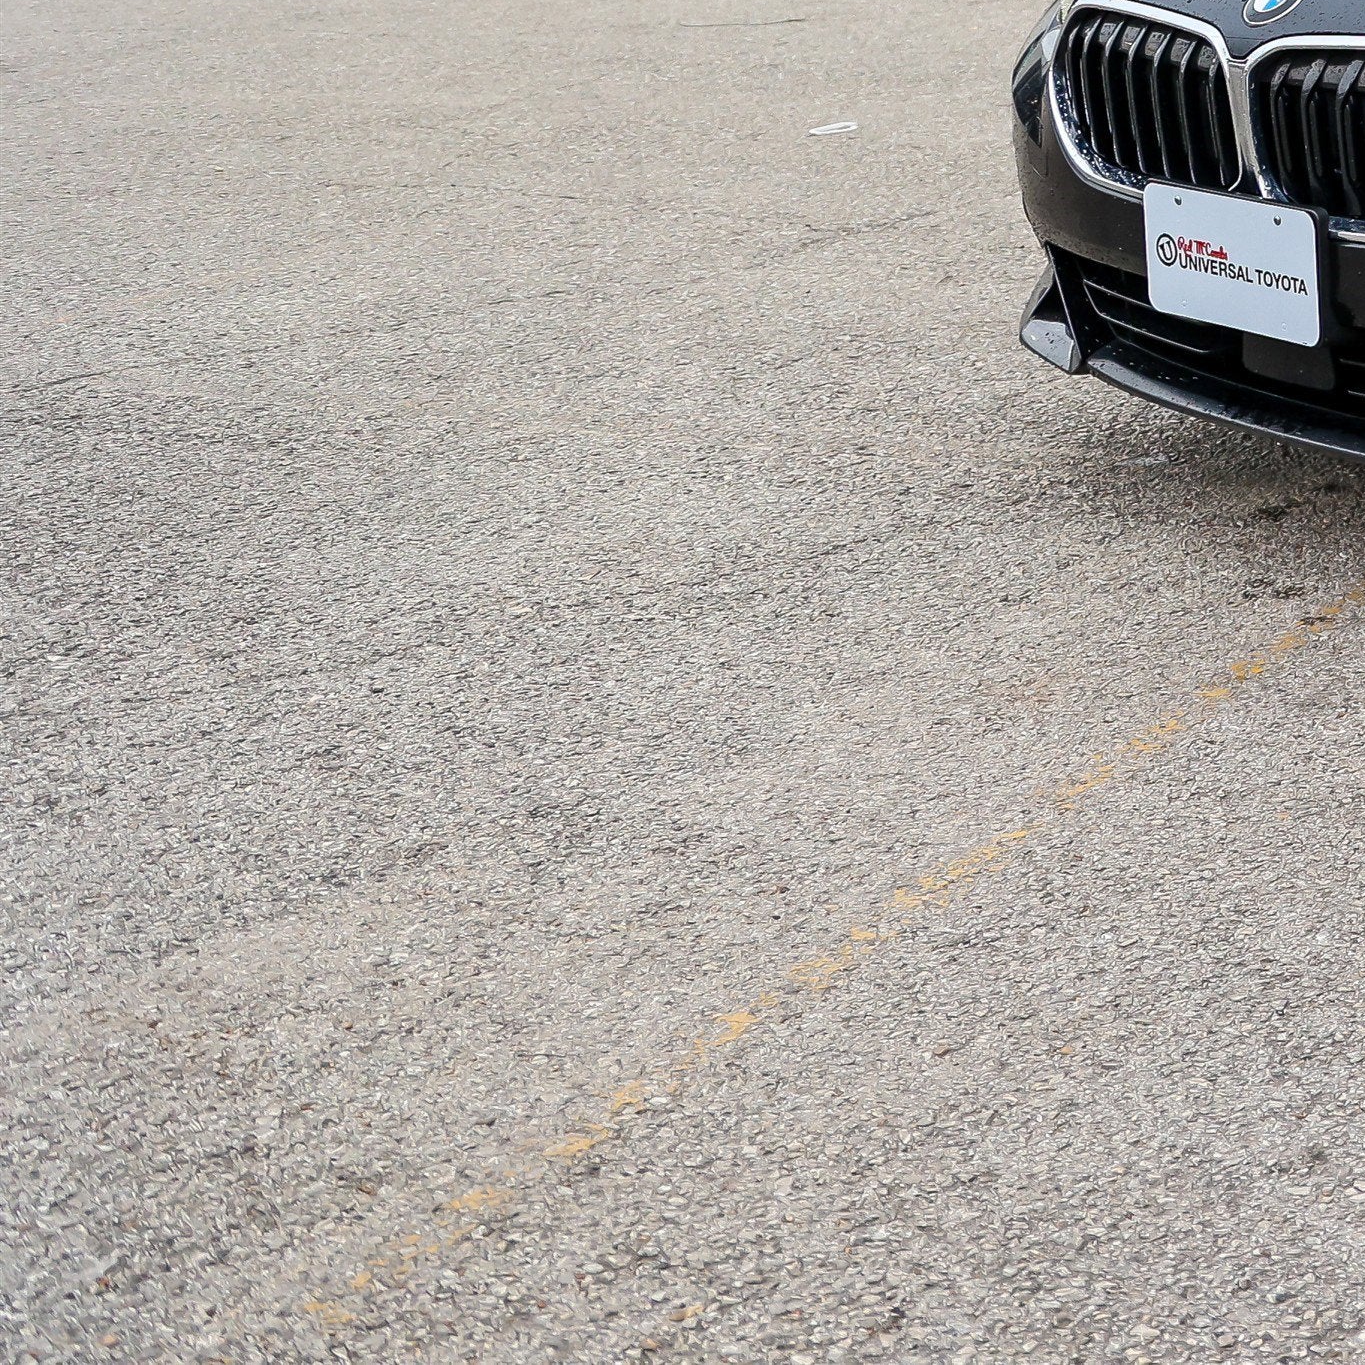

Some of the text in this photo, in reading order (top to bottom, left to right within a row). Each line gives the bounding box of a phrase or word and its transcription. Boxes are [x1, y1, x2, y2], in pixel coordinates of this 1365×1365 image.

[1177, 236, 1193, 257] Red
[1178, 252, 1308, 296] UNIVERSAL TOYOTA
